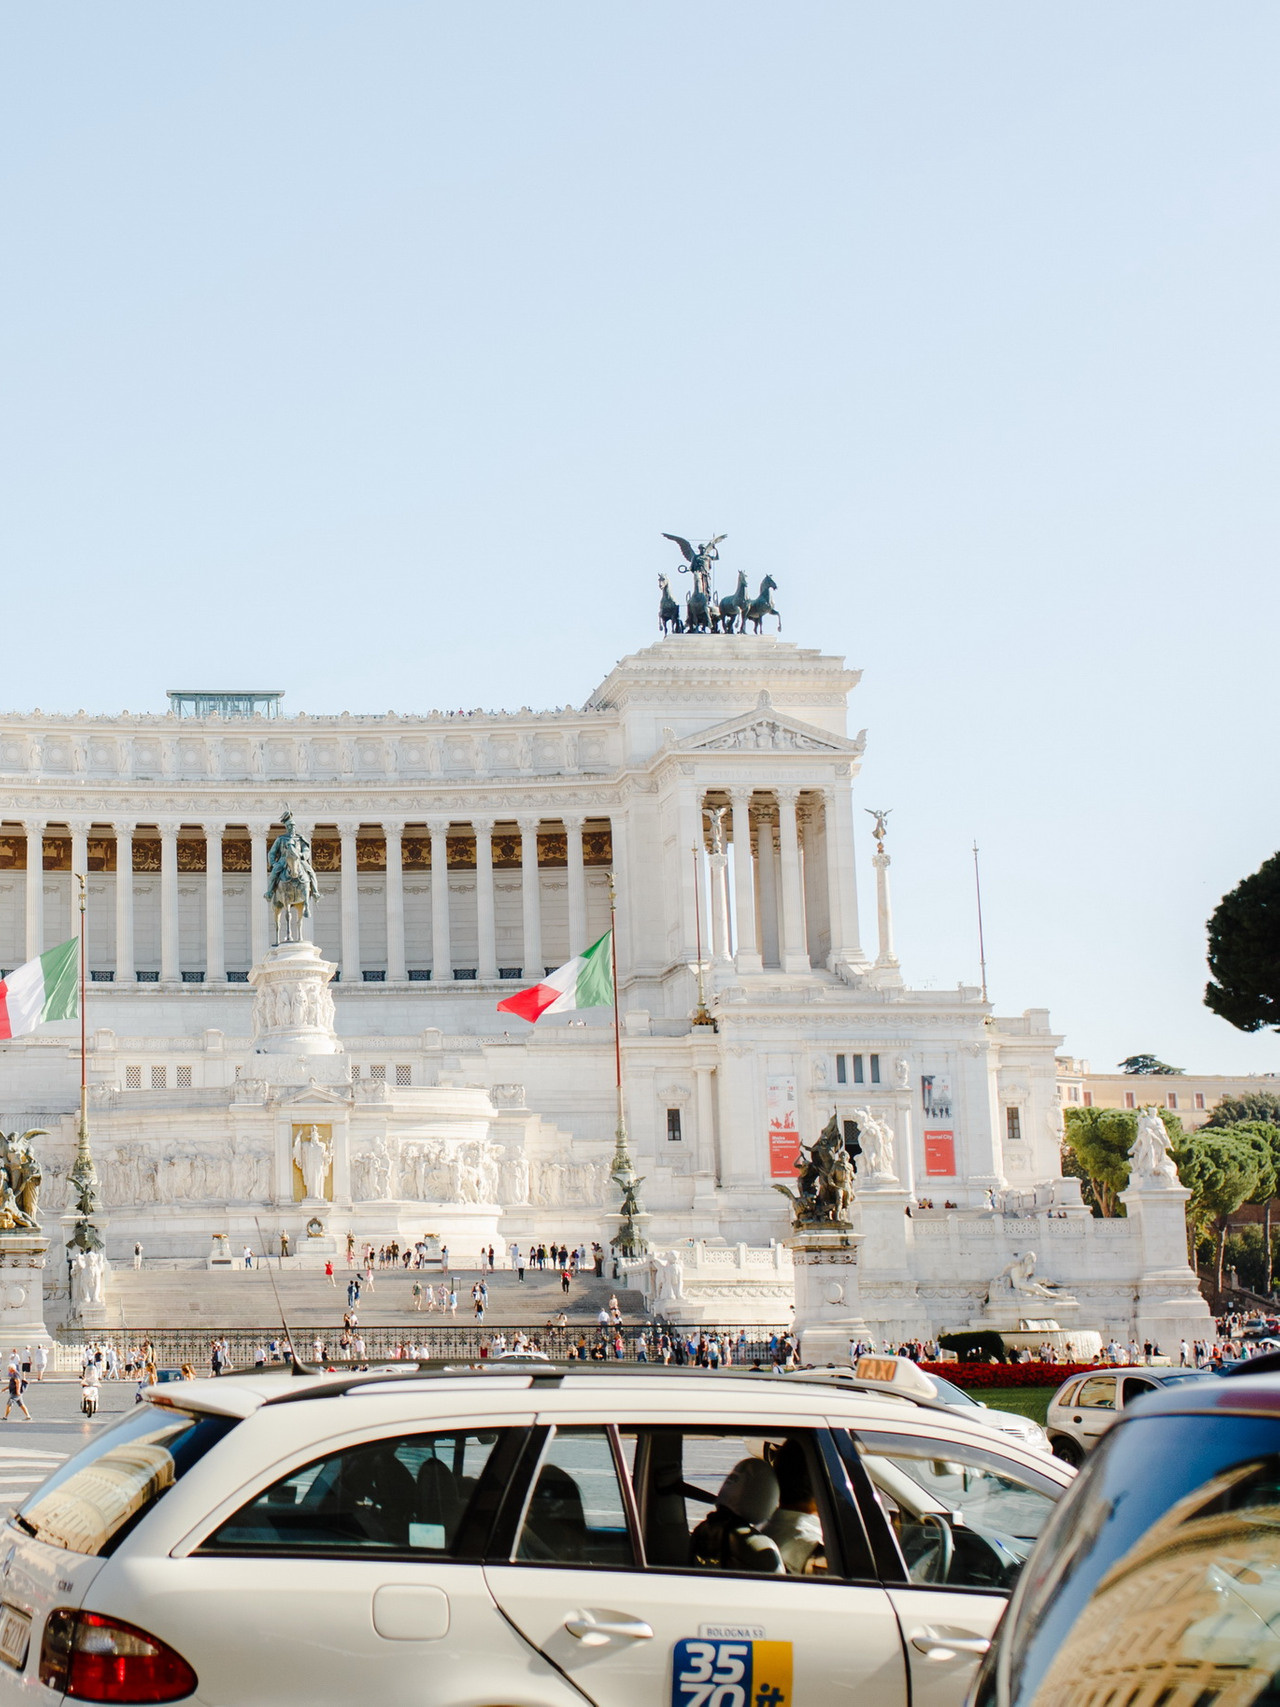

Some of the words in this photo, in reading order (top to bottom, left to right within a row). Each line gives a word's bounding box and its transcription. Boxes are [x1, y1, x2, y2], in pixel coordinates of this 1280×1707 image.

[858, 1359, 896, 1381] TAXI
[707, 1628, 751, 1638] BOLOGNA
[679, 1642, 748, 1684] 35
